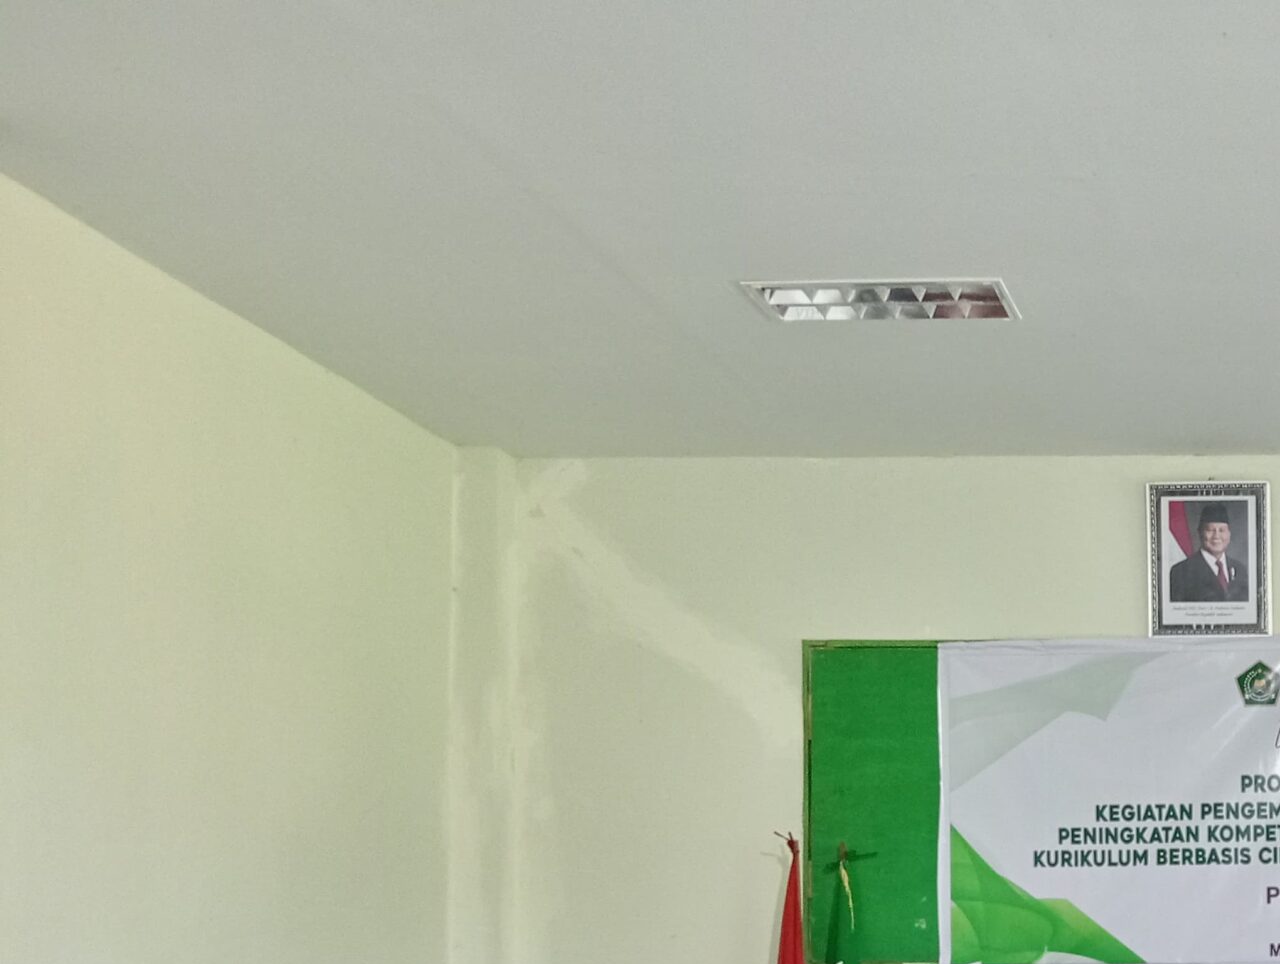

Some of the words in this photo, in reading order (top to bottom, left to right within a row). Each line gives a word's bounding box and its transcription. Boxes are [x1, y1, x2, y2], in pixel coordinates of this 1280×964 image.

[1096, 804, 1193, 822] KEGIATAN
[1058, 826, 1199, 844] PENINGKATAN
[1033, 850, 1149, 867] KURIKULUM
[1156, 848, 1251, 866] BERBASIS
